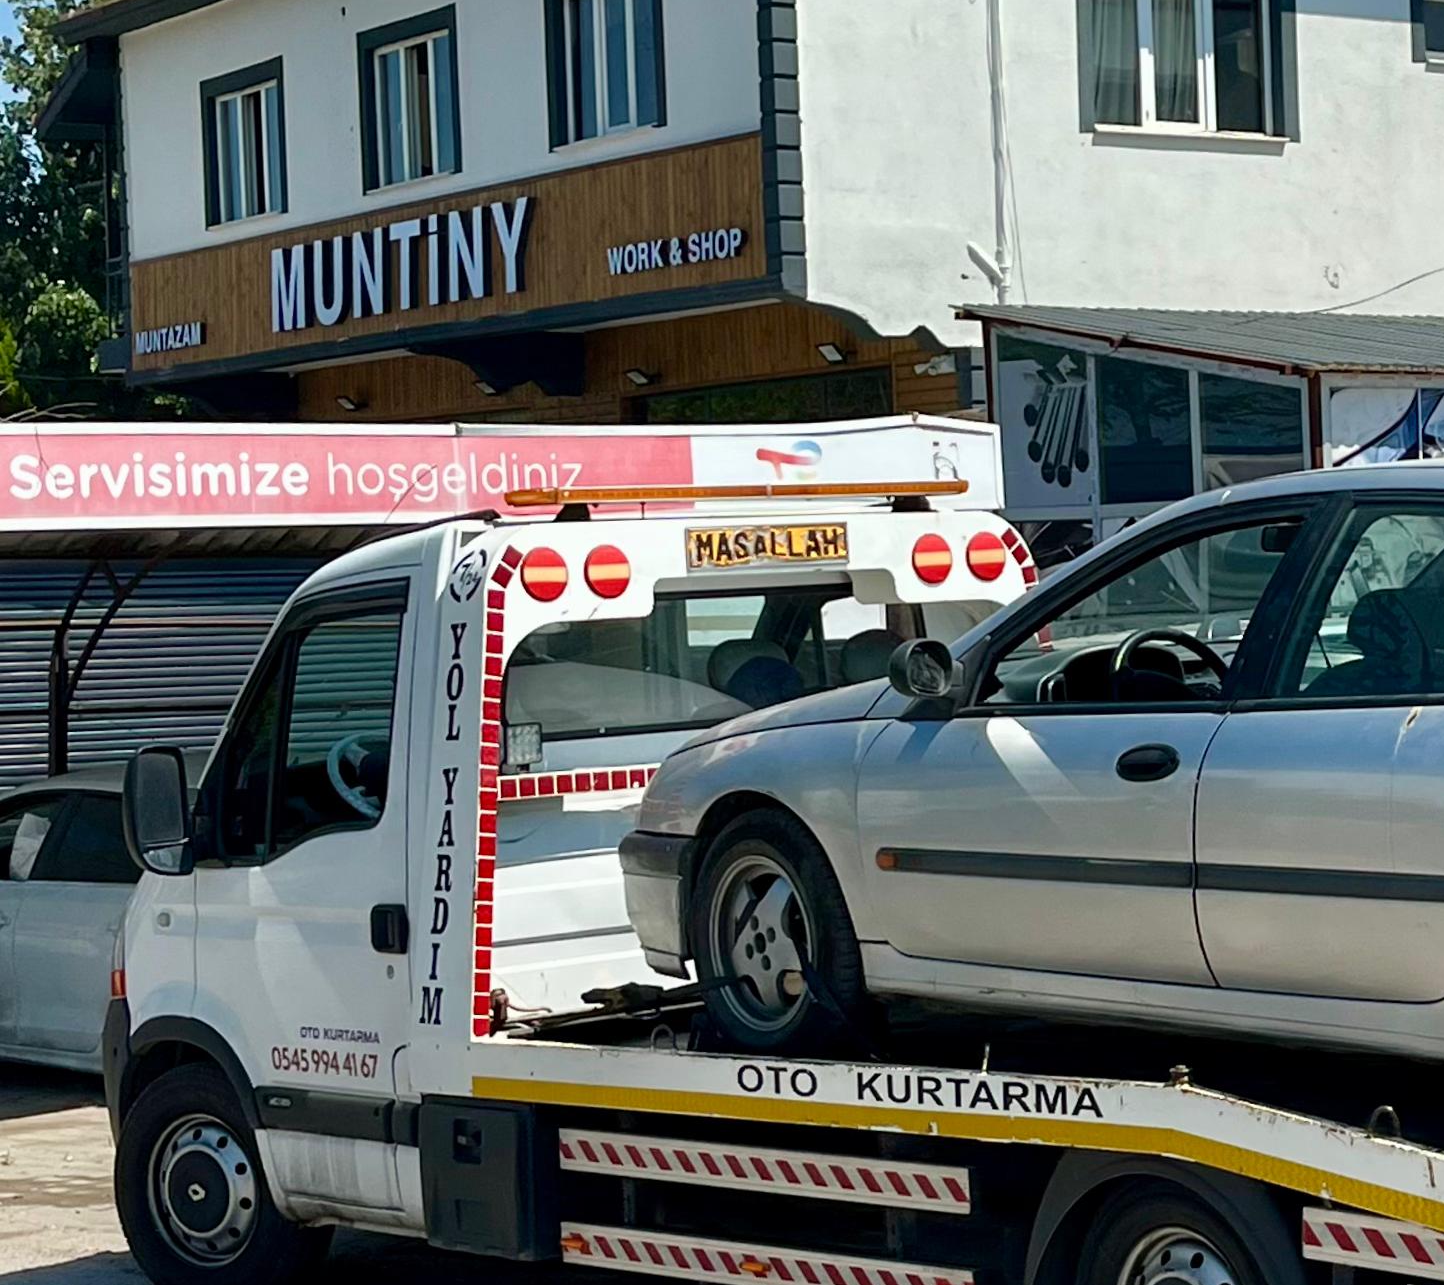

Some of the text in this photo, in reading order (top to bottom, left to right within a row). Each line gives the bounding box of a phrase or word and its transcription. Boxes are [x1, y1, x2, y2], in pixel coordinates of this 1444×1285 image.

[607, 227, 743, 276] WORK & SHOP
[135, 322, 202, 355] MUNTAZAM
[9, 451, 584, 503] Servisimize hoşgeldiniz
[418, 622, 467, 1027] YOL YARDIM
[300, 1026, 380, 1044] OTO KURTARMA
[271, 1046, 310, 1073] 0545
[311, 1049, 340, 1075] 994
[736, 1063, 1104, 1118] OTO KURTARMA
